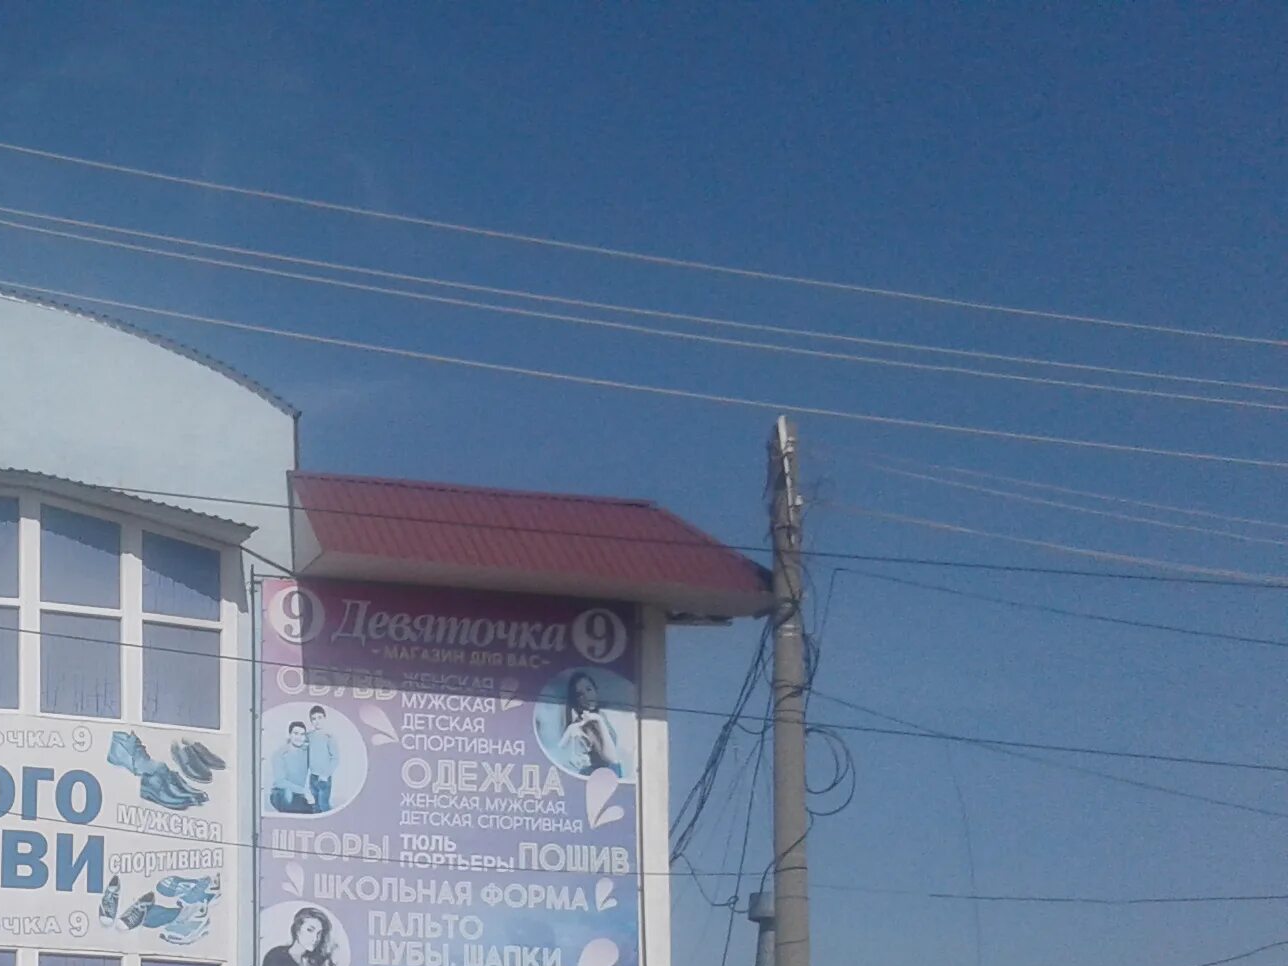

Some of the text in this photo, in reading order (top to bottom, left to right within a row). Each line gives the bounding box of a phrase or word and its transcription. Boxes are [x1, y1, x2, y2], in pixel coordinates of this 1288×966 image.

[331, 598, 569, 653] Девяточка
[276, 665, 398, 700] ОБУВЬ
[401, 692, 496, 713] МУЖСКАЯ
[401, 713, 485, 733] ДЕТСКАЯ
[71, 725, 93, 753] 9
[401, 734, 525, 756] СПОРТИВНАЯ
[401, 757, 565, 797] ОДЕЖДА
[117, 803, 223, 843] мужская
[477, 815, 583, 833] СПОРТИВНАЯ
[271, 828, 390, 864] ШТОРЫ
[400, 833, 456, 851] ТЮЛЬ
[109, 847, 224, 878] спортивная
[399, 851, 514, 872] ПОРТЬЕРЫ
[519, 841, 630, 874] ПОШИВ
[314, 873, 588, 912] ШКОЛЬНАЯ ФОРМА
[68, 910, 90, 938] 9
[368, 910, 484, 940] ПАЛЬТО
